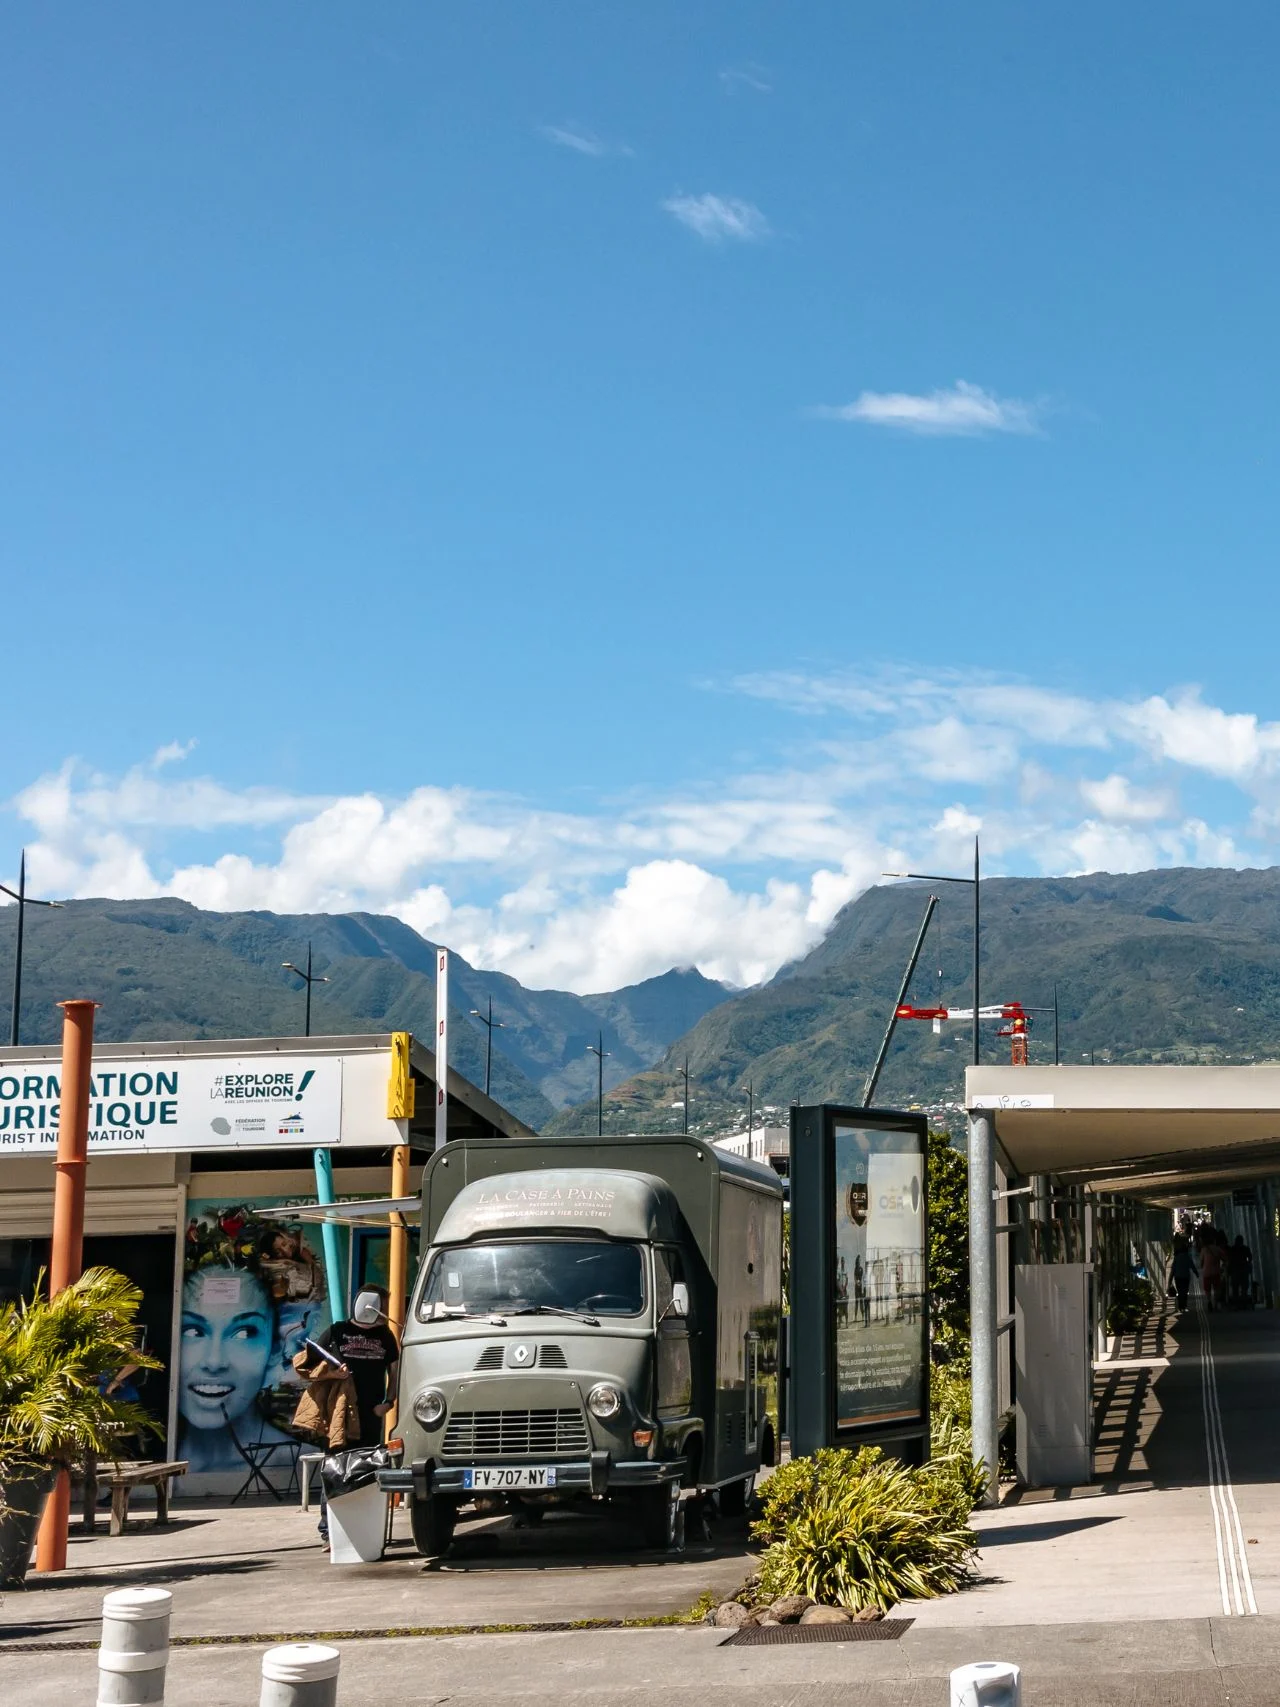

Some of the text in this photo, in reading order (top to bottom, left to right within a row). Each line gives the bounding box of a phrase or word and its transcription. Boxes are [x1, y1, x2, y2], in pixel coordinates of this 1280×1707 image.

[214, 1073, 294, 1087] #EXPLORE
[0, 1101, 178, 1130] RIIQUE
[0, 1129, 145, 1144] RIST INMATION
[477, 1193, 500, 1204] LA
[505, 1190, 548, 1201] CASE
[567, 1188, 616, 1201] PAINS
[474, 1469, 546, 1486] FV-707-NY
